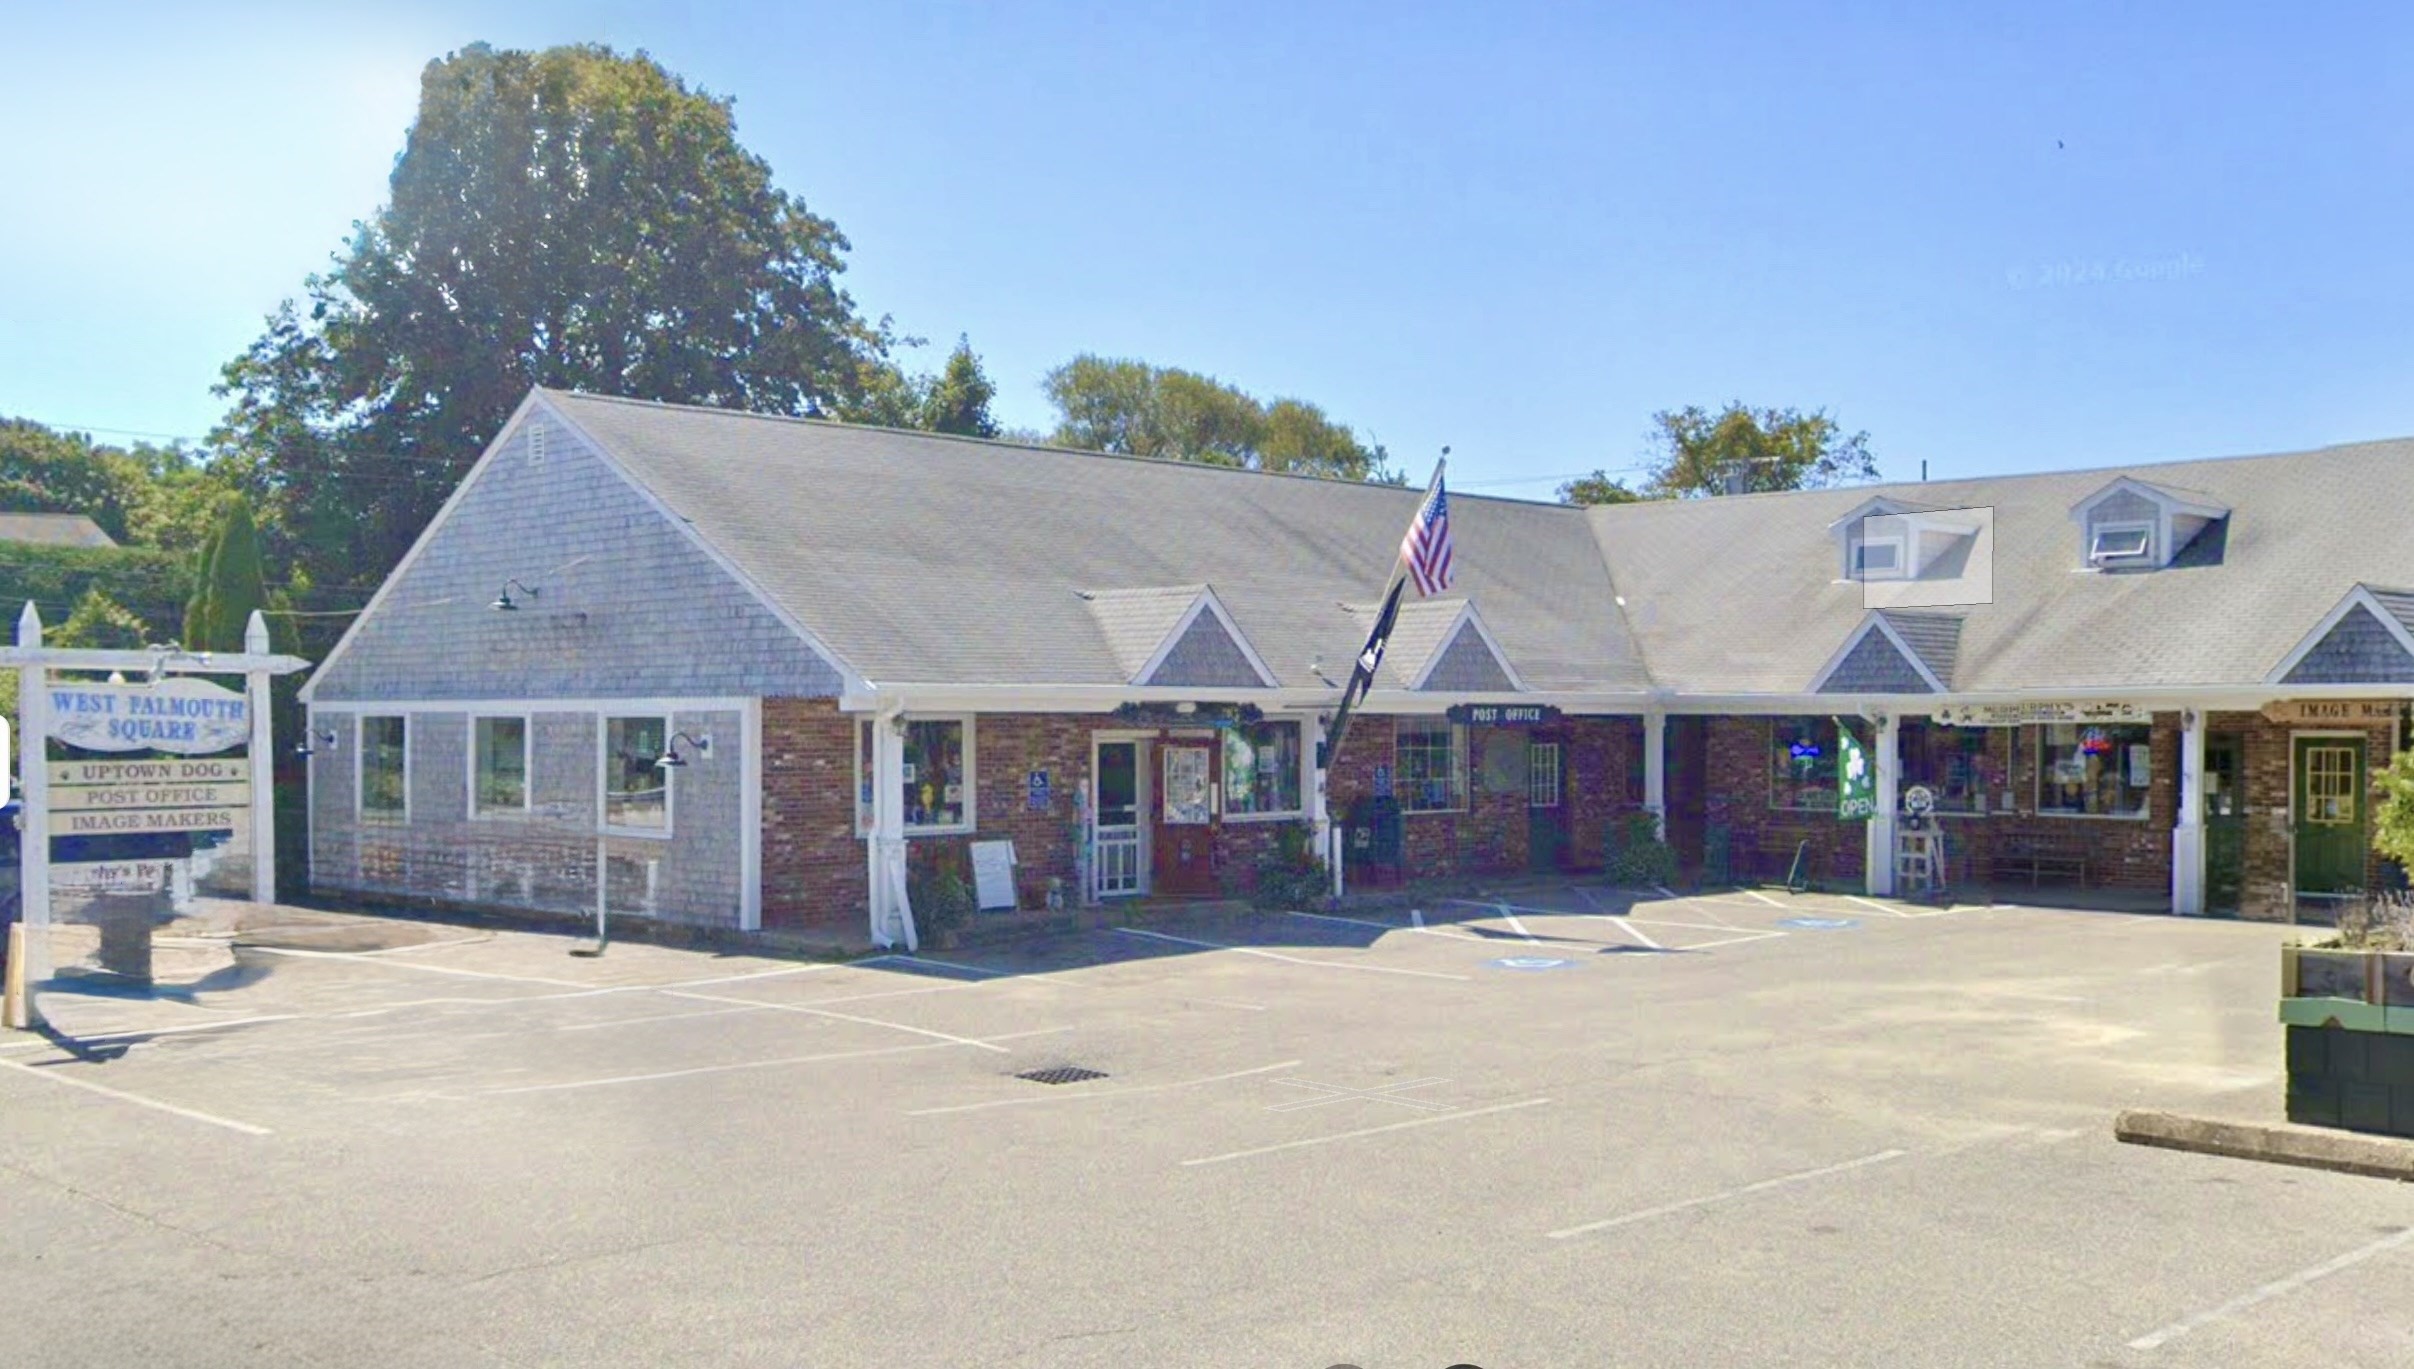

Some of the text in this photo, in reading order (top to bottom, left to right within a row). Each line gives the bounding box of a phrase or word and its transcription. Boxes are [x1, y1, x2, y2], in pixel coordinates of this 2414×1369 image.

[52, 692, 244, 717] WEST FALMOUTH
[2301, 703, 2350, 717] IMAGE
[1472, 708, 1541, 721] POST OFFICE
[109, 719, 197, 741] SQUARE
[83, 762, 223, 779] UPTOWN DOG
[88, 787, 217, 805] POST OFFICE
[1840, 795, 1878, 817] OPEN
[72, 812, 232, 830] IMAGE MAKERS
